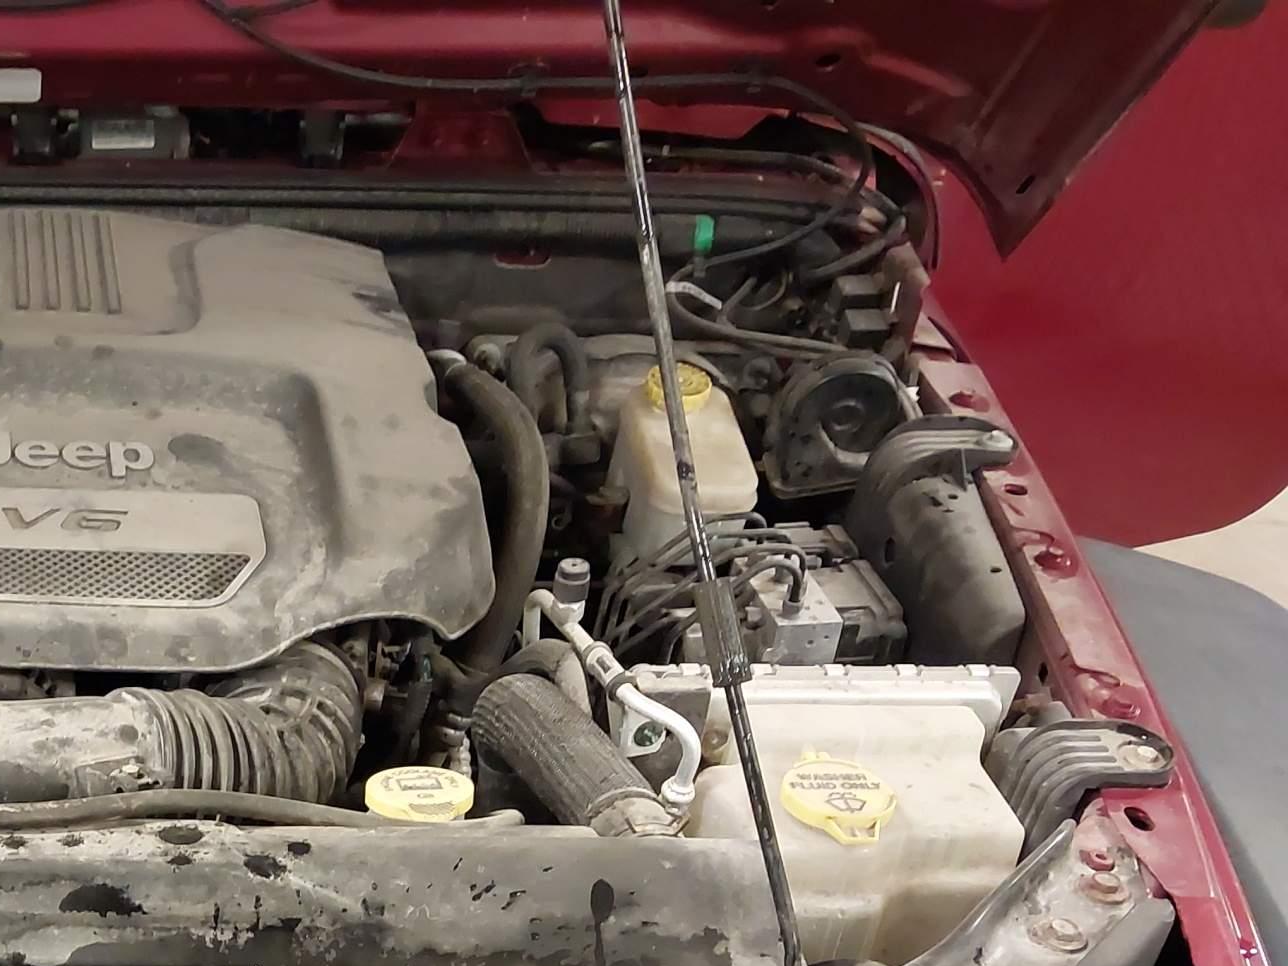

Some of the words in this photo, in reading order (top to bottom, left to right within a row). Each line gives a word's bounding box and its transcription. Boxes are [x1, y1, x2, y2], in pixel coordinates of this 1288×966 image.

[2, 506, 129, 532] V6
[795, 772, 868, 782] WASHER
[789, 781, 837, 790] FLUID
[840, 781, 881, 790] ONLY
